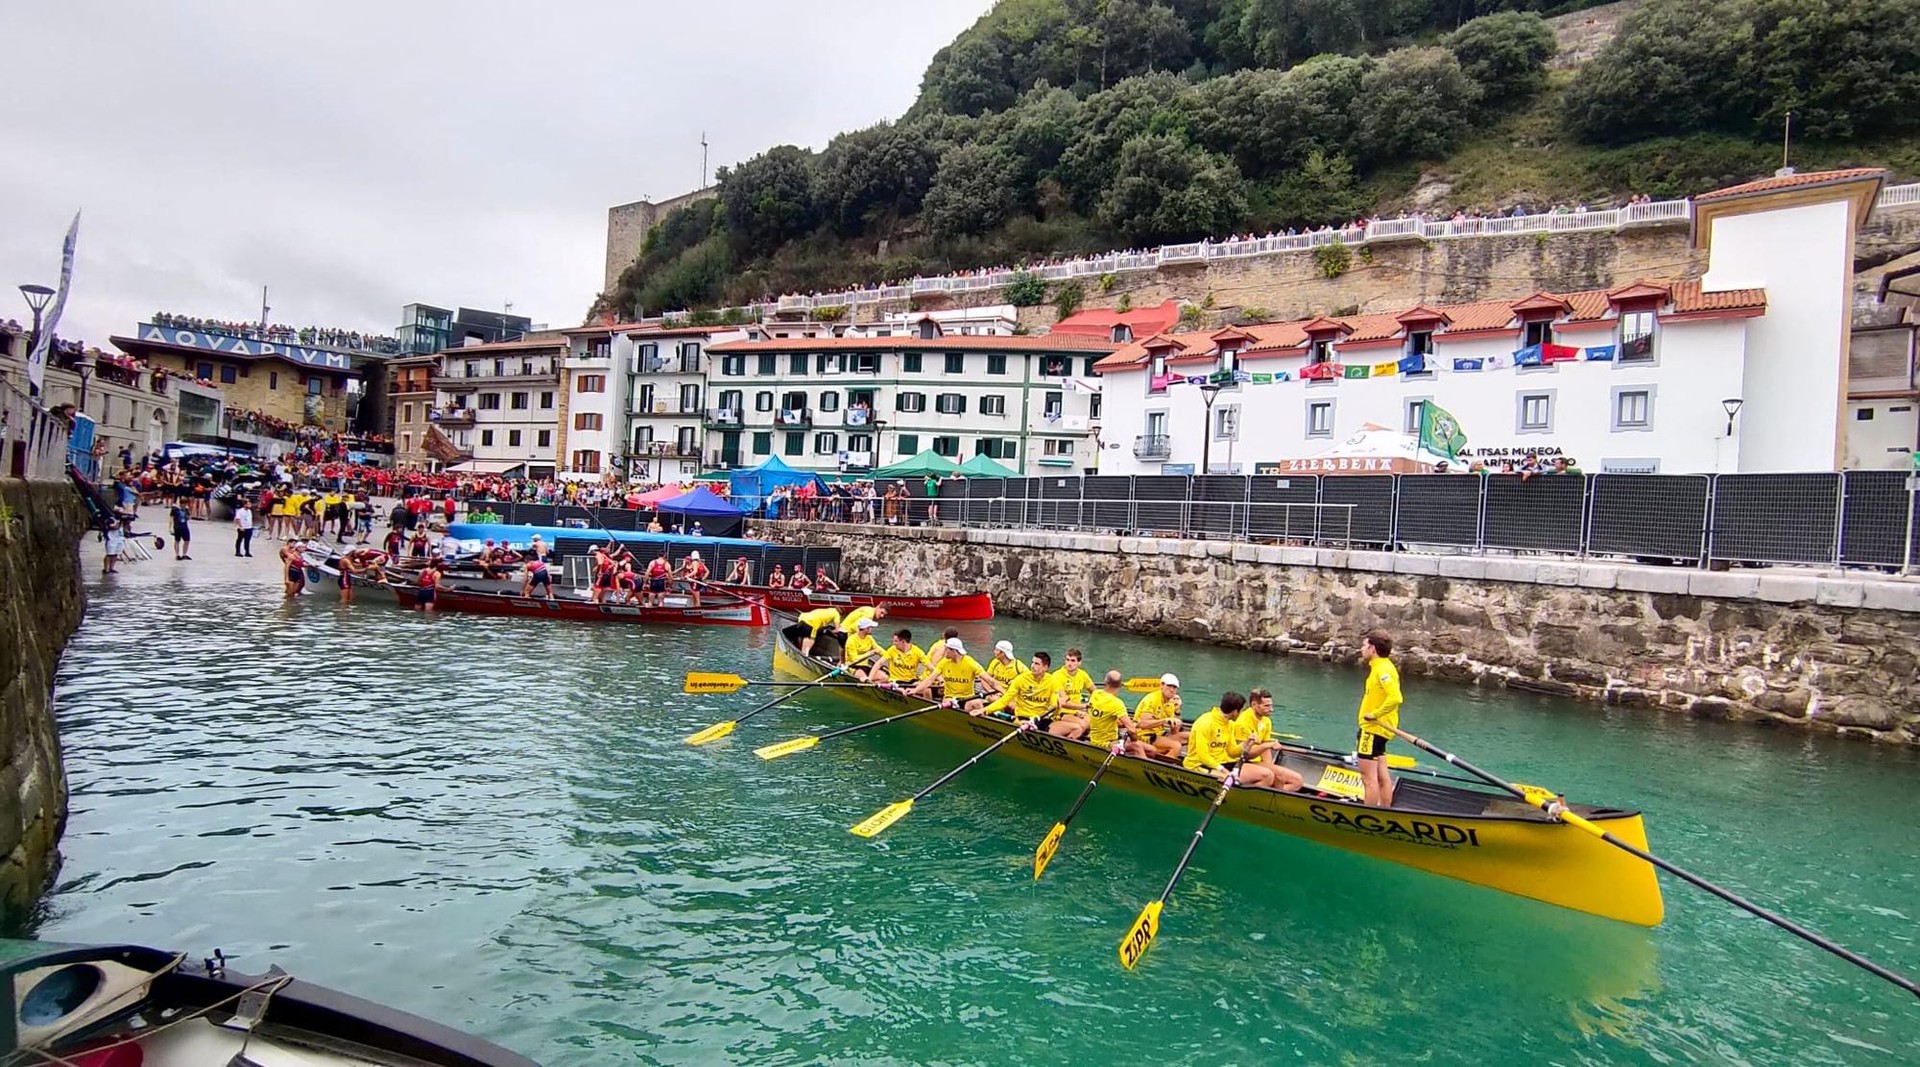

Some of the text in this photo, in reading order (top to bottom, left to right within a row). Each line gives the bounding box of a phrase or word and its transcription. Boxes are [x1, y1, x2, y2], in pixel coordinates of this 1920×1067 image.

[1477, 447, 1508, 456] ITSAS
[1512, 446, 1562, 456] MUSEOA
[1289, 458, 1393, 471] ZIERBENA
[1309, 804, 1481, 847] SAGARDI
